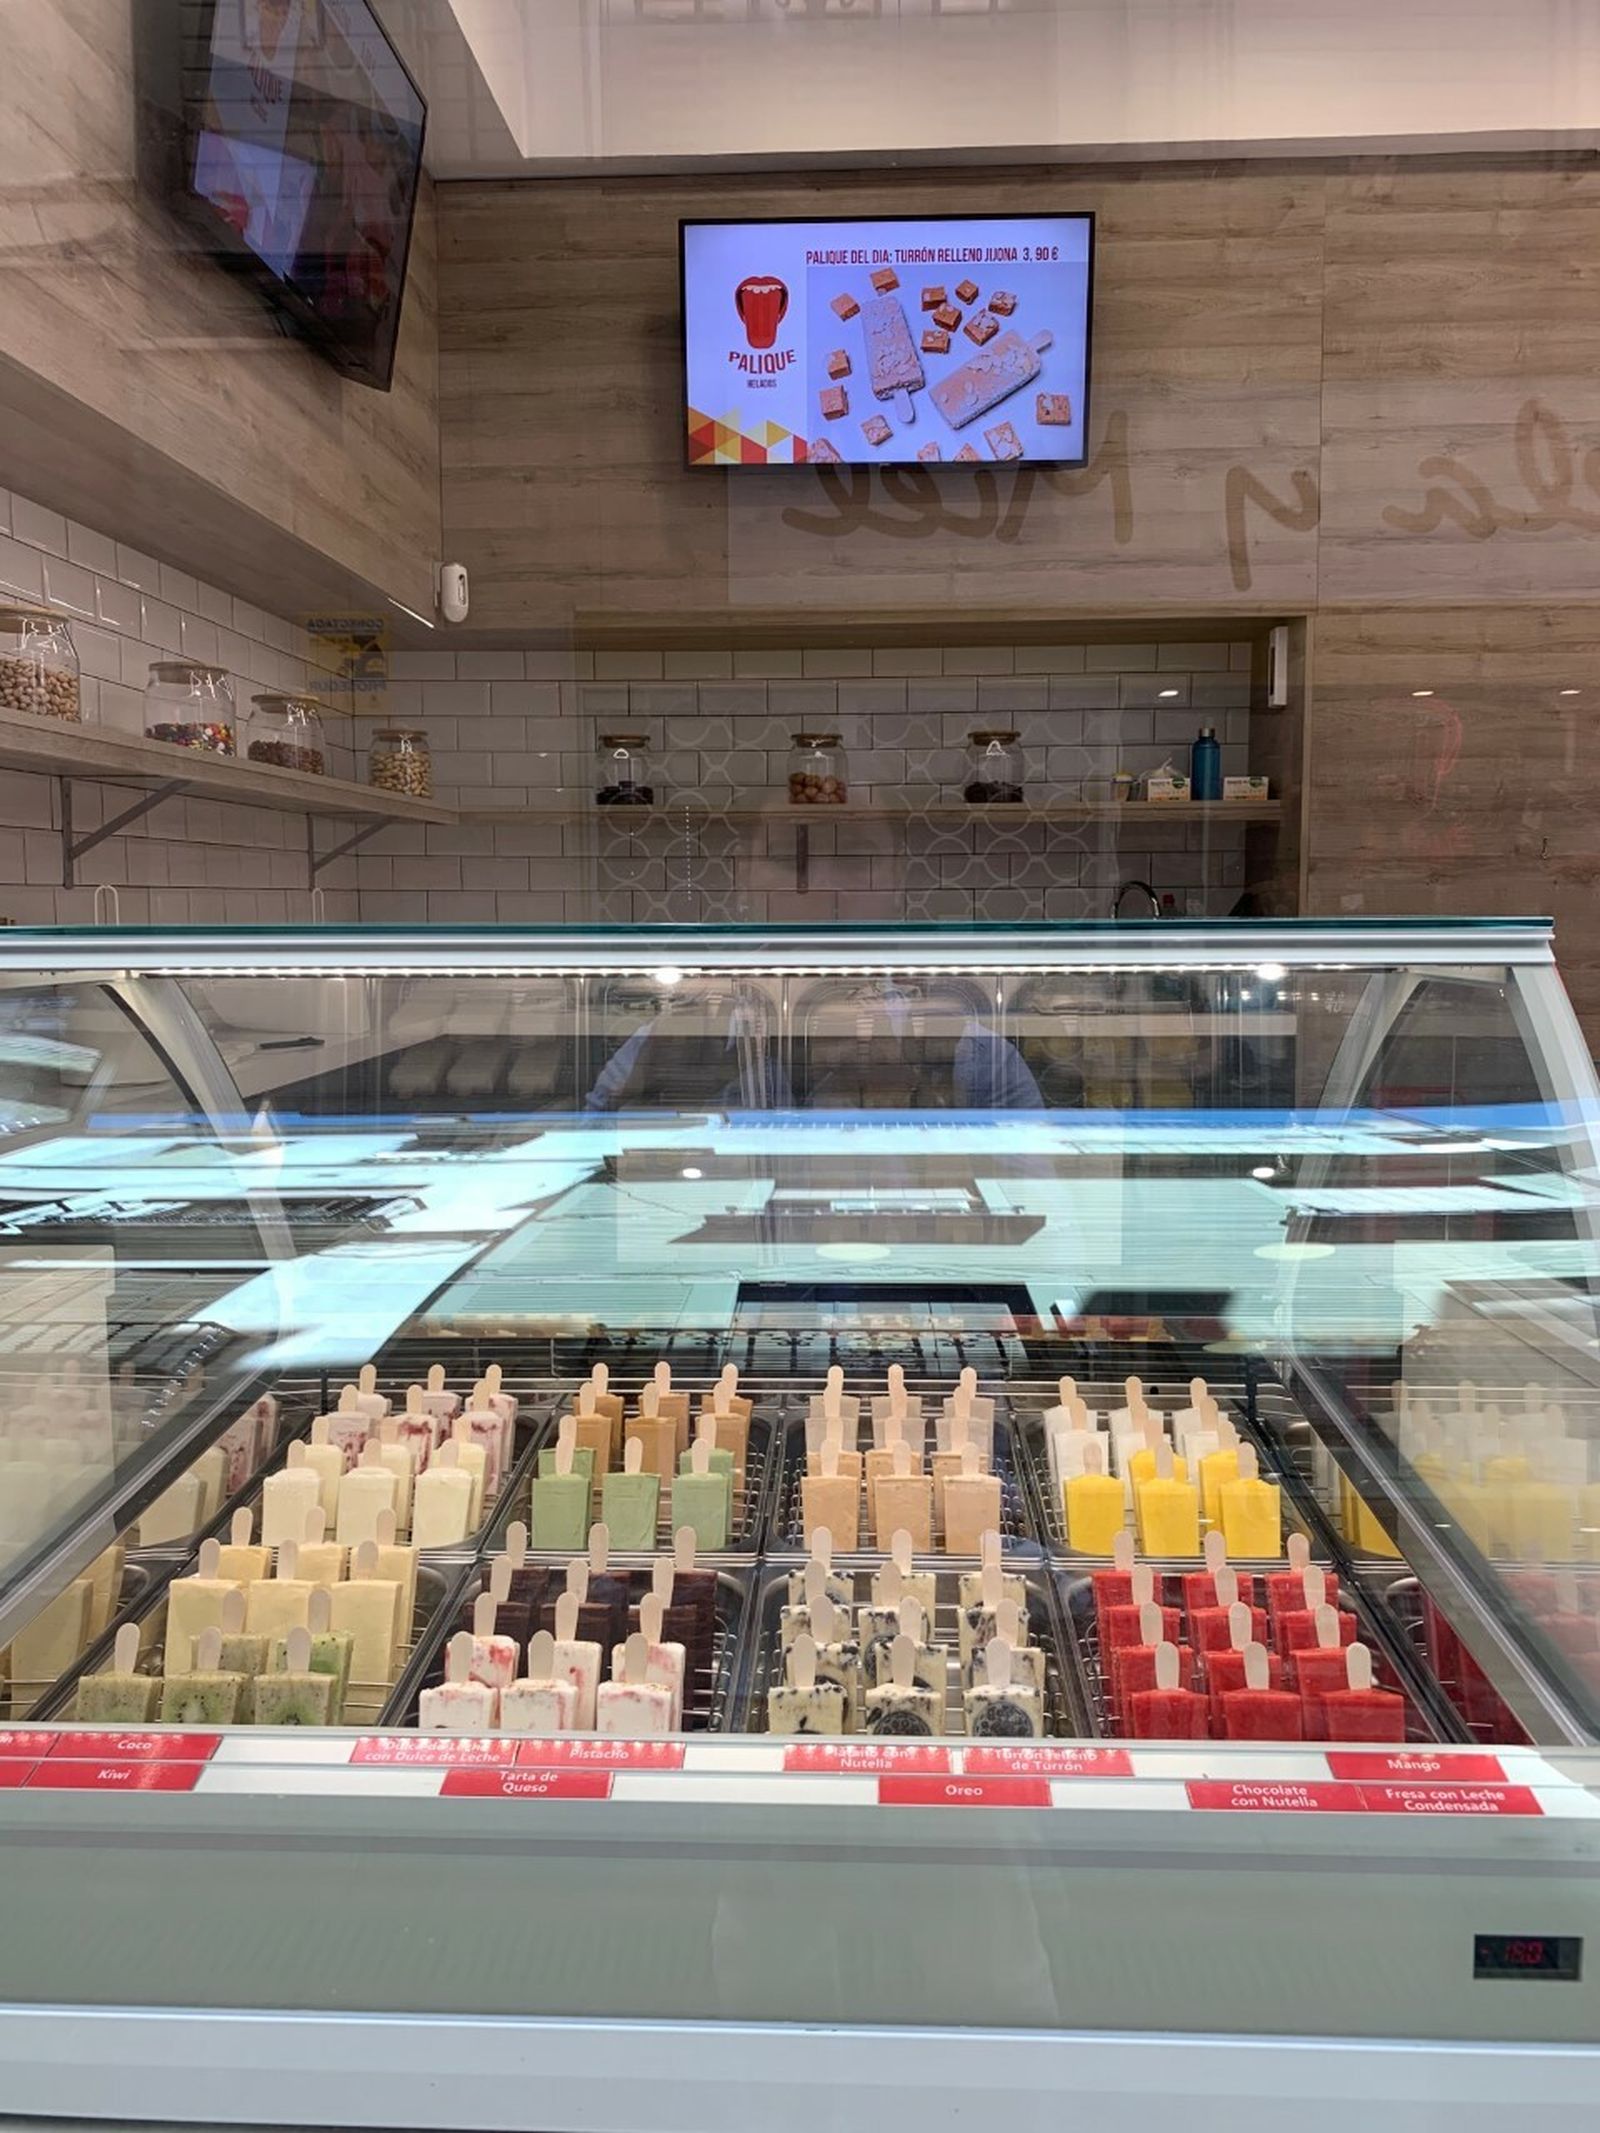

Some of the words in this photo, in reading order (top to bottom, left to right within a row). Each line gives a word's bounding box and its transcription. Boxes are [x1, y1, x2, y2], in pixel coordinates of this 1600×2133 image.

[806, 250, 848, 265] PALIQUE
[851, 249, 869, 264] DEL
[873, 249, 892, 263] DIA:
[895, 246, 936, 262] TURRÓN
[938, 248, 982, 262] RELLENO
[985, 247, 1018, 261] JIJONA
[729, 349, 796, 374] PALIQUE
[117, 1740, 152, 1750] Coco
[364, 1751, 391, 1761] con
[396, 1751, 435, 1761] Dulce
[438, 1752, 456, 1762] de
[460, 1752, 500, 1762] Leche
[569, 1749, 629, 1759] Pistacho
[840, 1758, 892, 1769] Nutella
[1011, 1761, 1029, 1770] de
[1034, 1760, 1083, 1771] Turrón
[1387, 1760, 1441, 1772] Mango
[97, 1769, 131, 1780] Kiwi
[500, 1771, 534, 1782] Tarta
[540, 1772, 558, 1782] de
[502, 1782, 548, 1793] Queso
[945, 1784, 983, 1796] Oreo
[1232, 1784, 1308, 1796] Chocolate
[1386, 1788, 1426, 1800] Fresa
[1430, 1790, 1458, 1800] con
[1461, 1789, 1505, 1801] Leche
[1231, 1797, 1259, 1807] con
[1263, 1796, 1318, 1808] Nutella
[1404, 1800, 1499, 1812] Condensada
